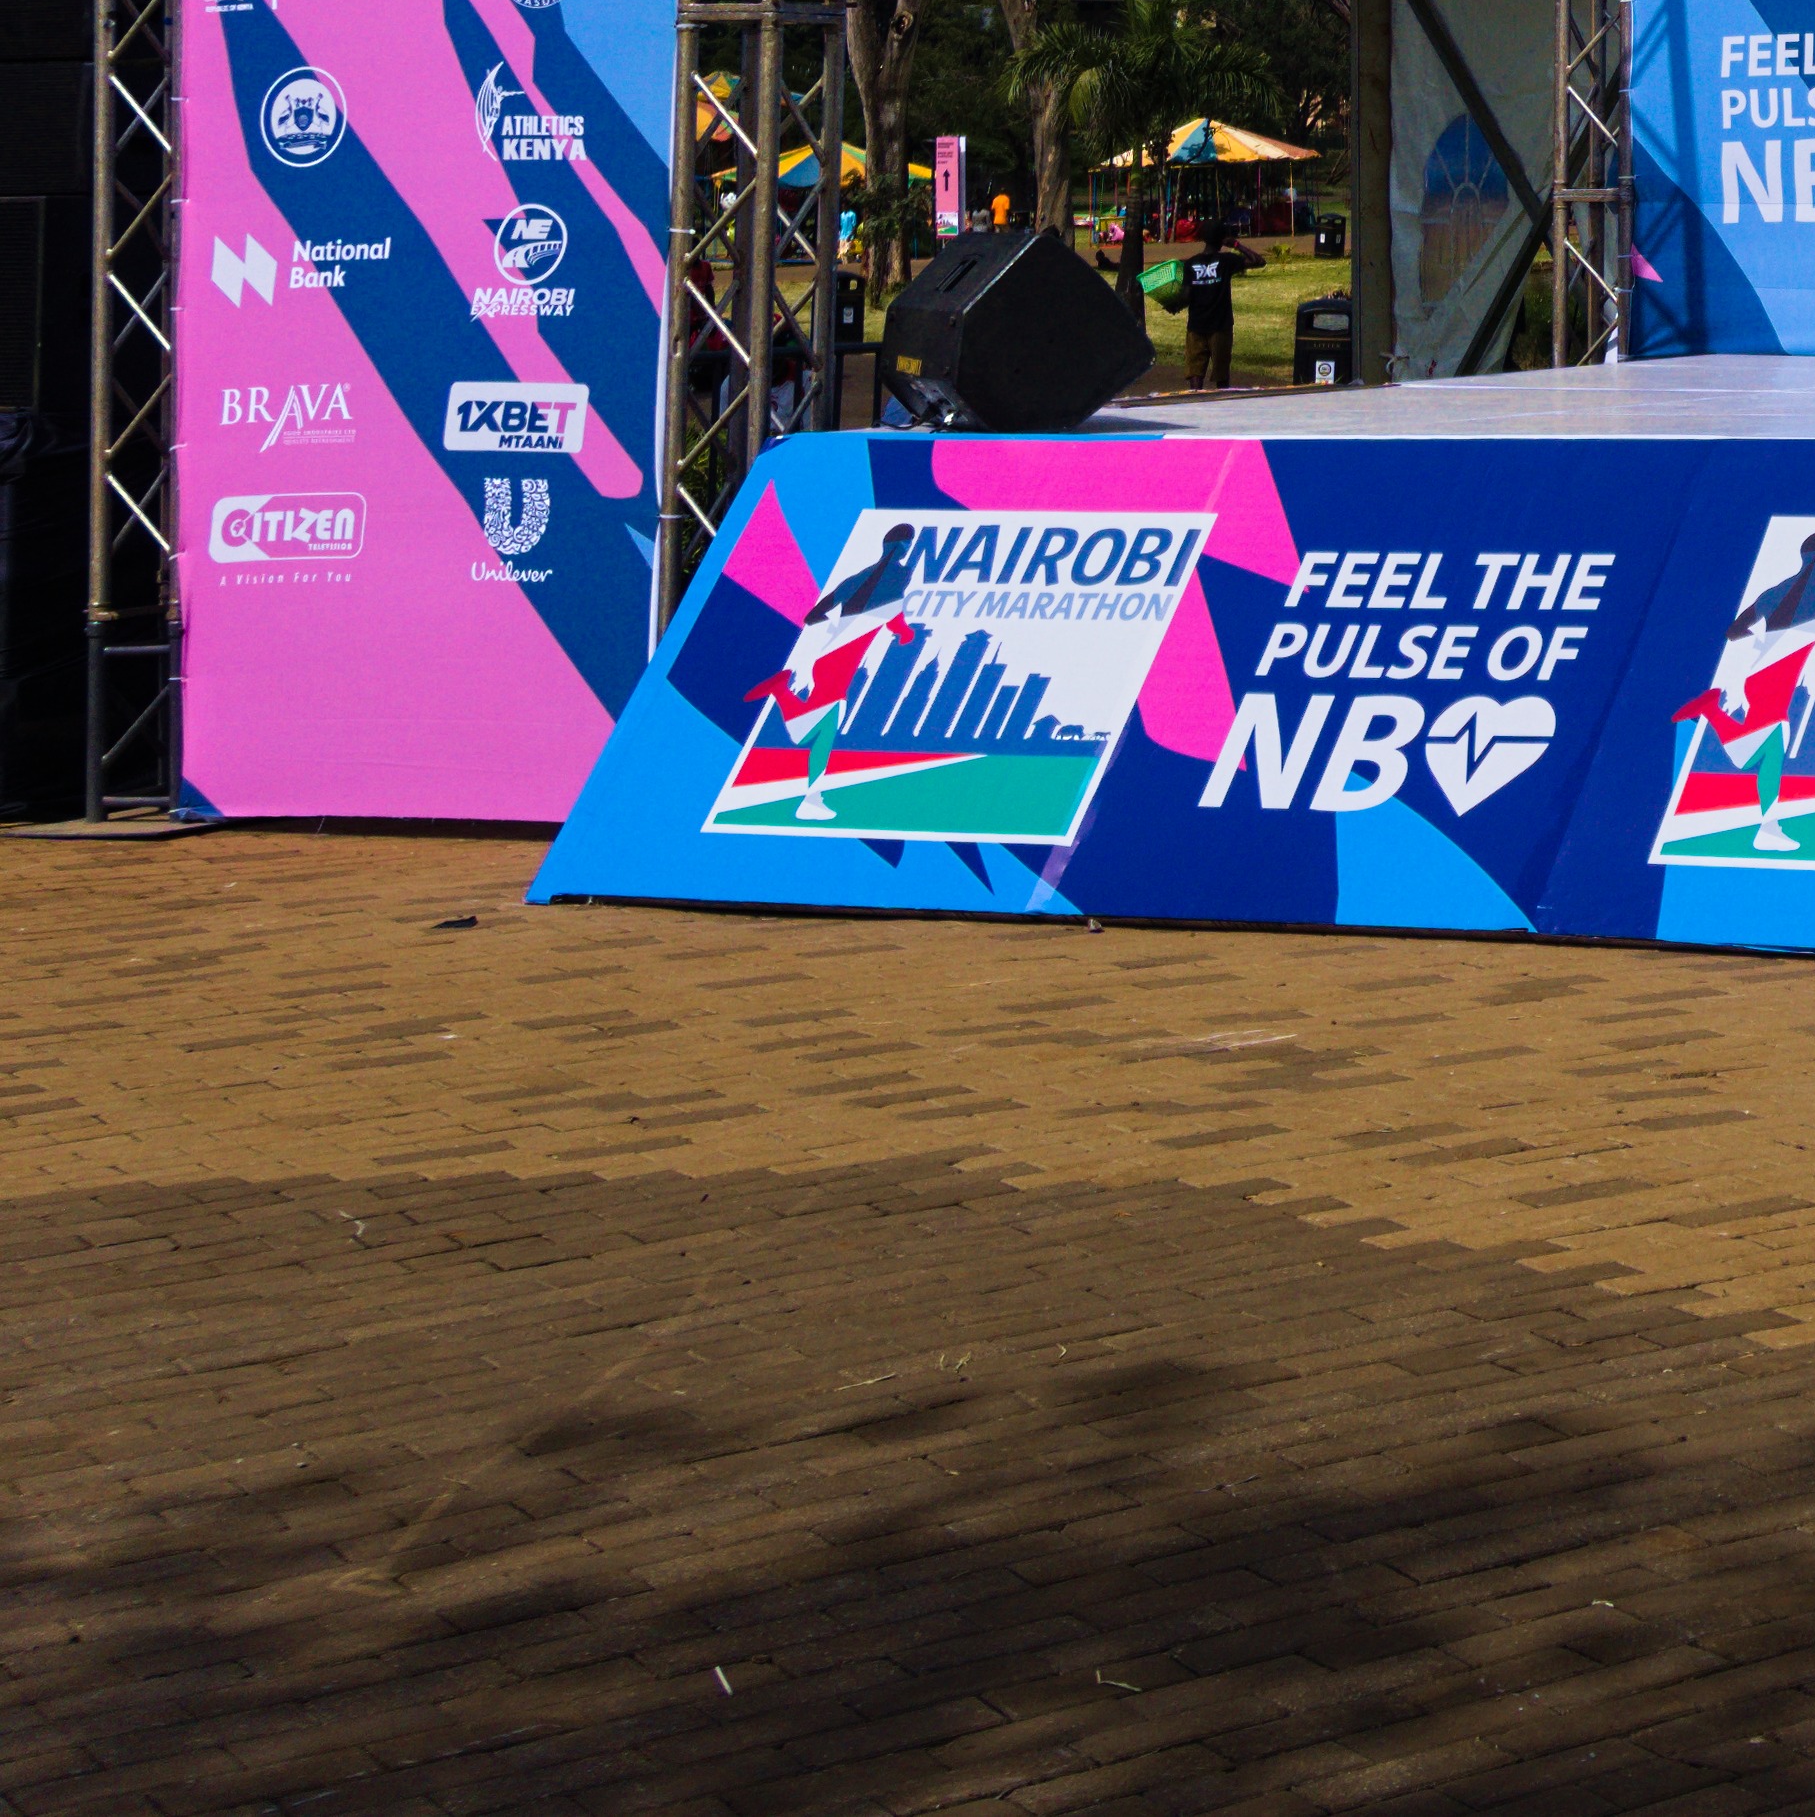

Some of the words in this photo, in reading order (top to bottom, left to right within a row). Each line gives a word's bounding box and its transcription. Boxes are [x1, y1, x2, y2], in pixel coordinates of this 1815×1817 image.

[501, 115, 585, 136] ATHLETICS
[503, 139, 587, 160] KENYA
[292, 236, 391, 262] National
[289, 265, 346, 289] Bank
[473, 287, 575, 306] NAIROBI
[470, 303, 575, 321] EXPRESSWAY
[457, 400, 577, 434] 1XBET
[905, 525, 1201, 588] NAIROBI
[220, 576, 226, 586] A
[237, 573, 283, 585] Vision
[294, 572, 317, 583] For
[328, 571, 351, 582] You
[471, 561, 553, 583] Unilever
[1284, 552, 1448, 610] FEEL
[1473, 553, 1615, 611] THE
[901, 589, 982, 620] CITY
[980, 591, 1174, 622] MARATHON
[1256, 625, 1478, 680] PULSE
[1488, 625, 1589, 681] OF
